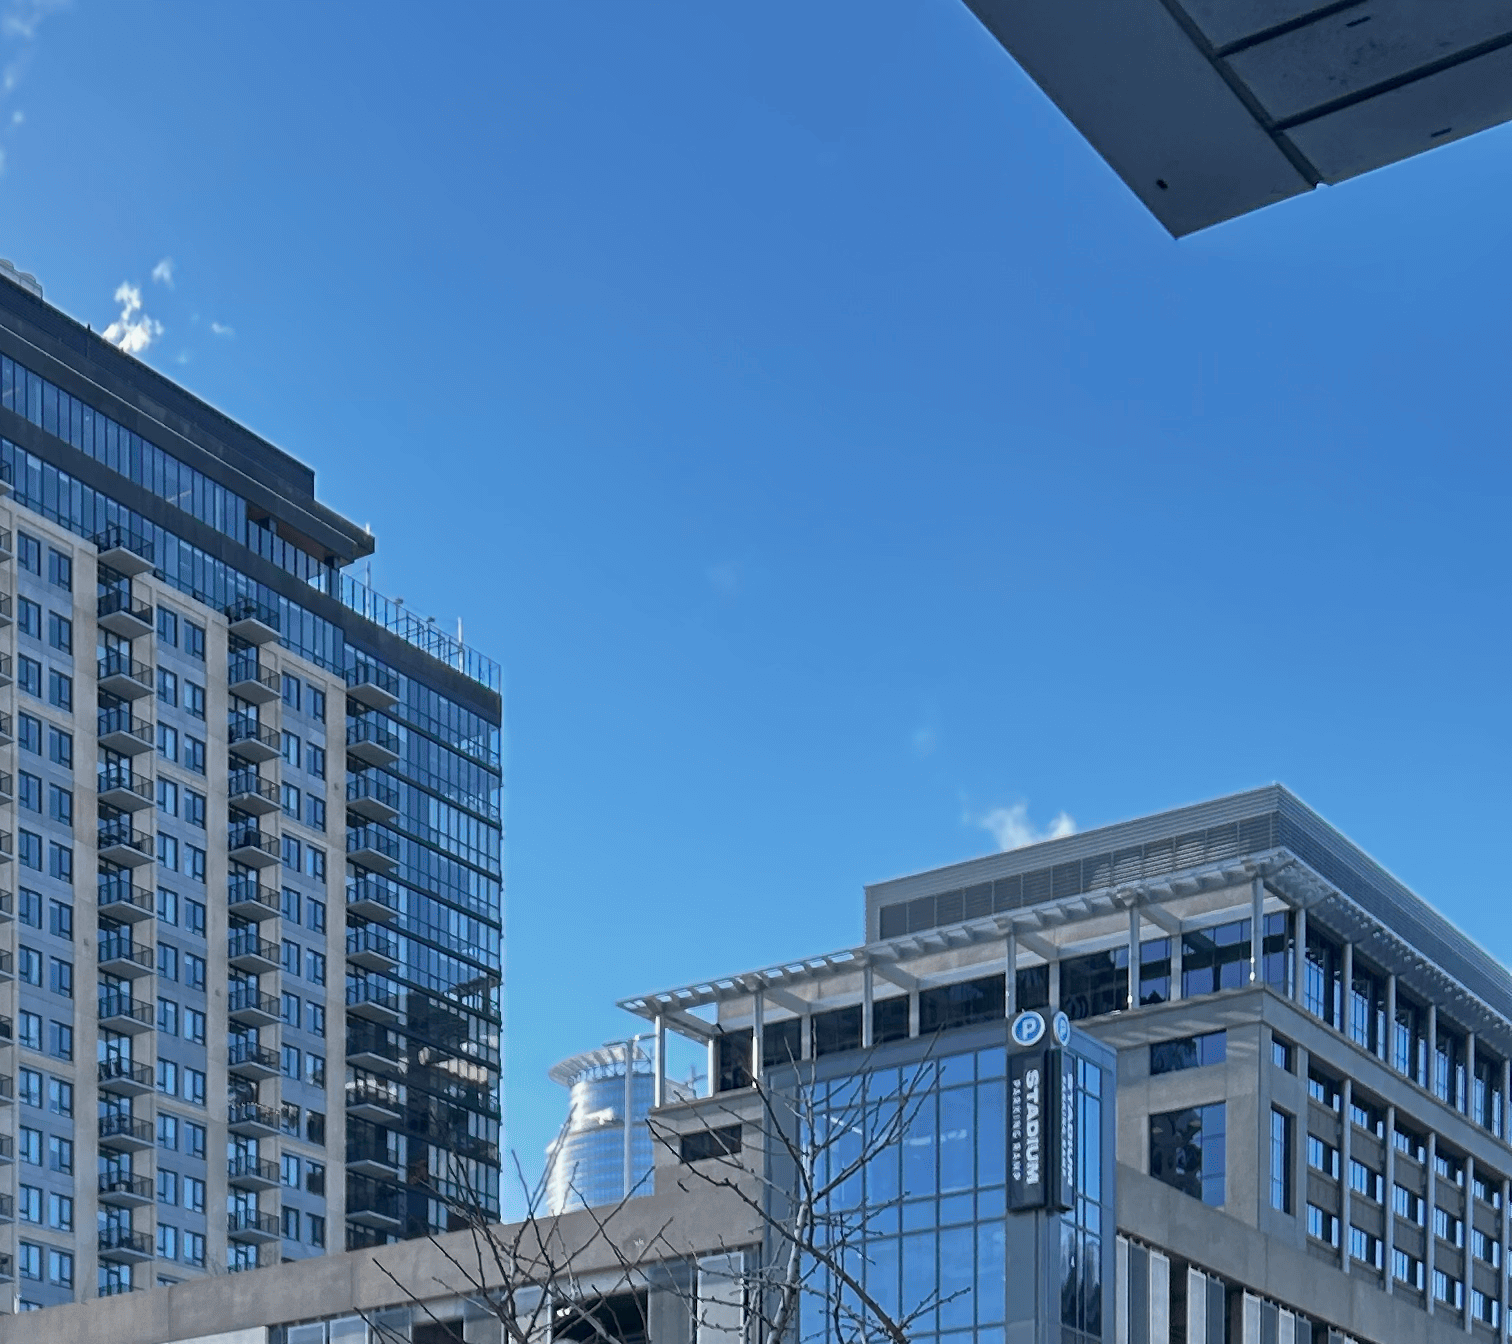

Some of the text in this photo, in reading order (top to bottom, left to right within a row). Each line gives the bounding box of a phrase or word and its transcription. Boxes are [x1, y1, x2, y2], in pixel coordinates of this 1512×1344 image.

[1012, 1079, 1022, 1181] PARKING RAMP
[1025, 1069, 1040, 1185] STADIUM
